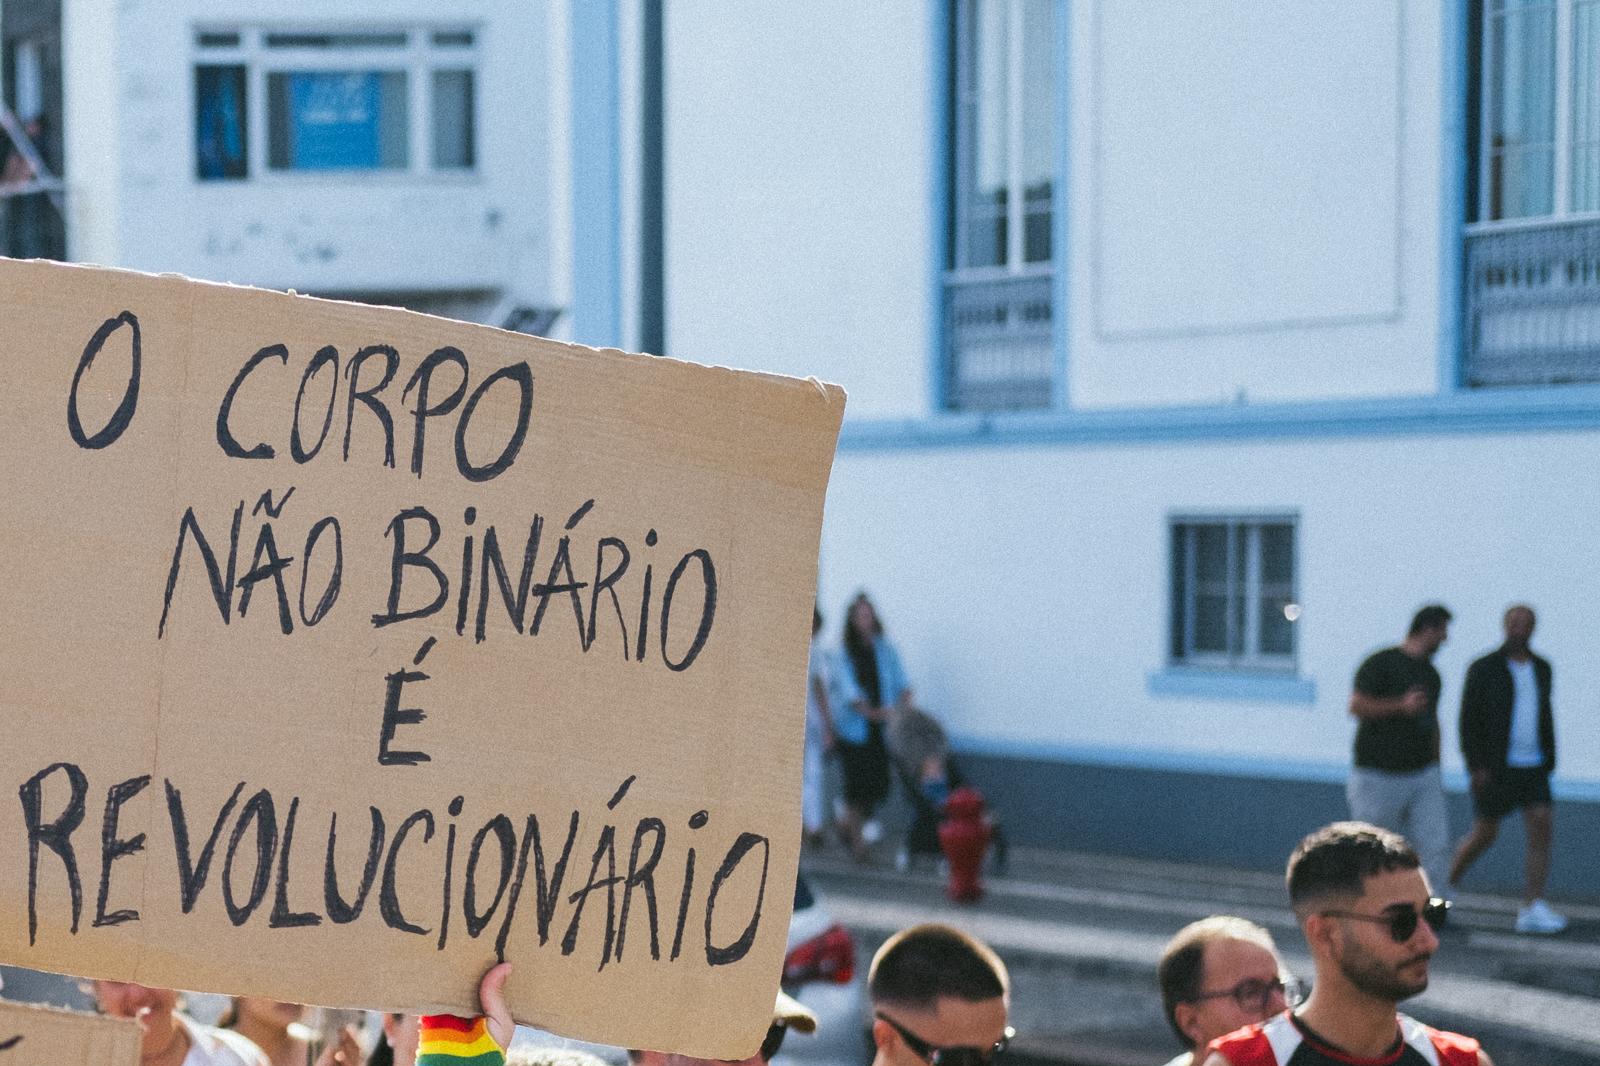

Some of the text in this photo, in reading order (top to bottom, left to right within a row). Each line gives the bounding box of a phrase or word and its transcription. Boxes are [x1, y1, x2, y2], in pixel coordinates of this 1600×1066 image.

[67, 310, 535, 482] O CORPO
[158, 487, 343, 639] NÃO
[377, 637, 438, 766] É
